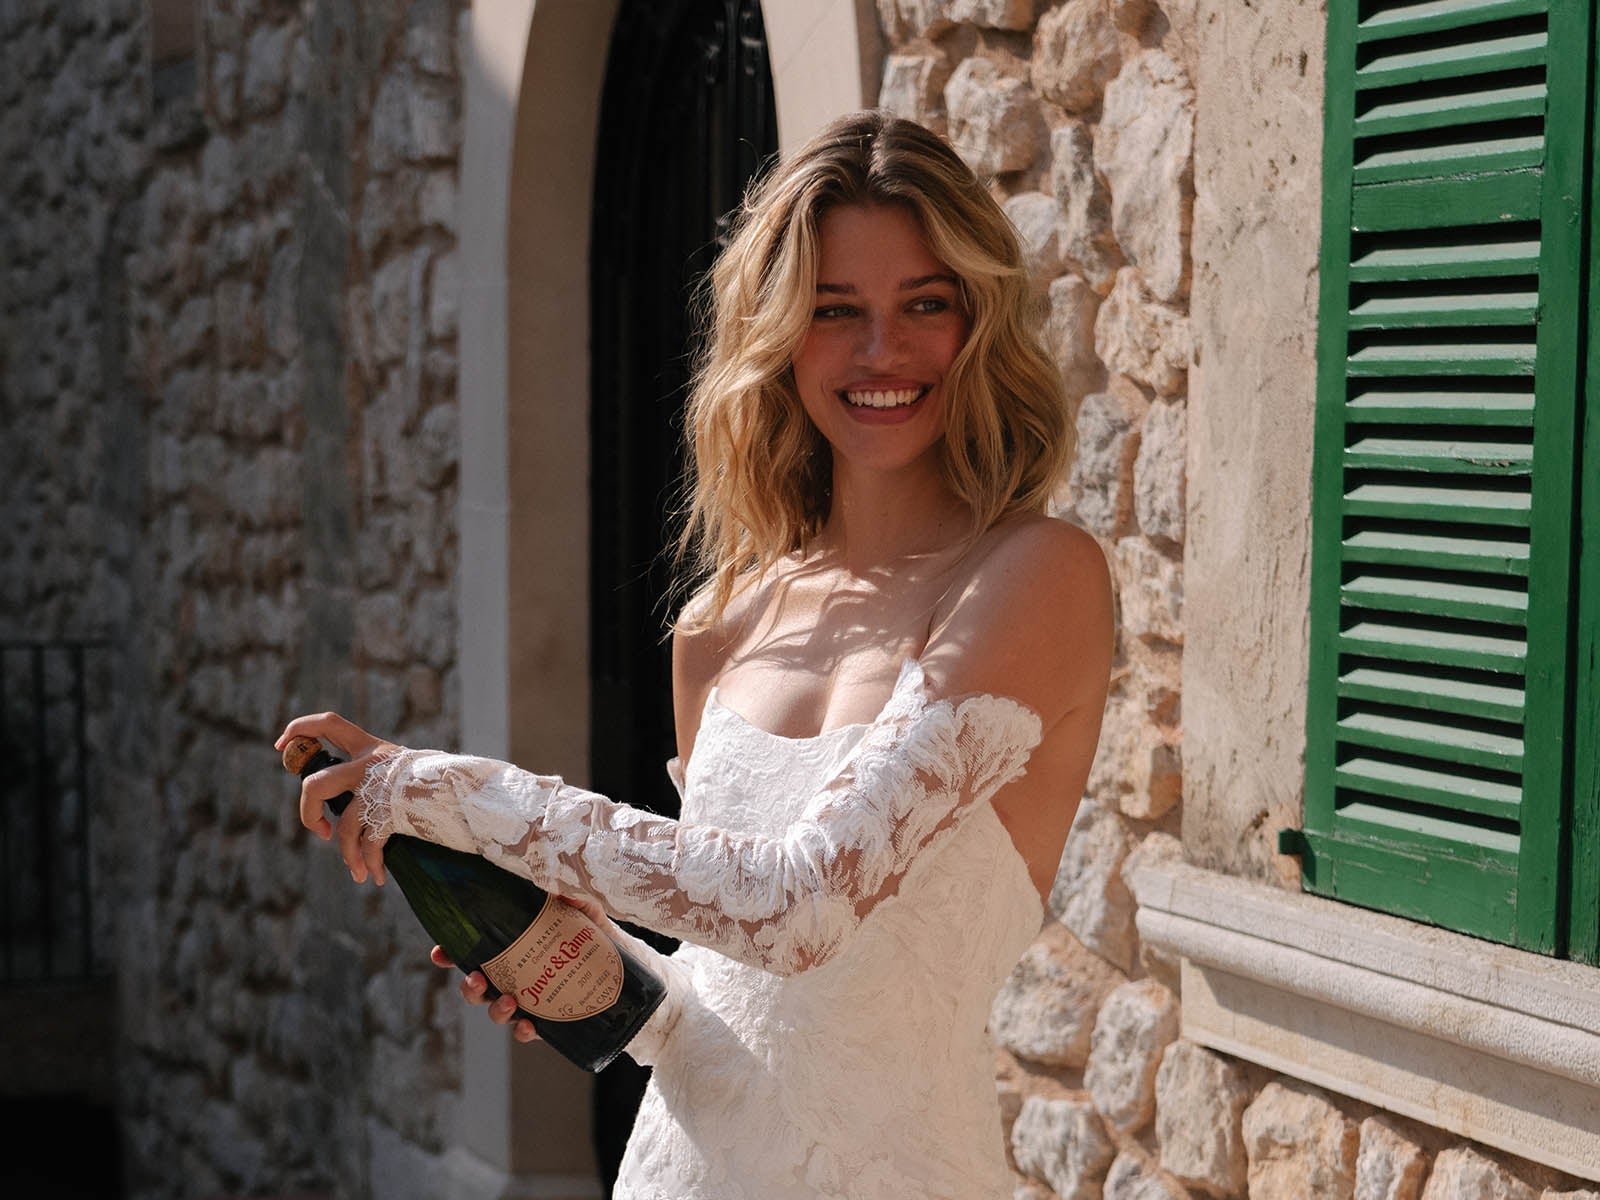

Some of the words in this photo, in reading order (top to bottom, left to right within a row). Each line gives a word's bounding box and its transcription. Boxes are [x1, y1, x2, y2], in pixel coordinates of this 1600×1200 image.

[517, 947, 536, 968] BRUT
[536, 918, 562, 946] NATURE
[559, 926, 596, 960] Camps
[550, 955, 570, 970] &
[521, 964, 556, 1006] Juvé
[546, 978, 569, 1003] RESERVA
[566, 969, 577, 979] DE
[574, 961, 583, 970] LA
[596, 986, 616, 1004] CAVA
